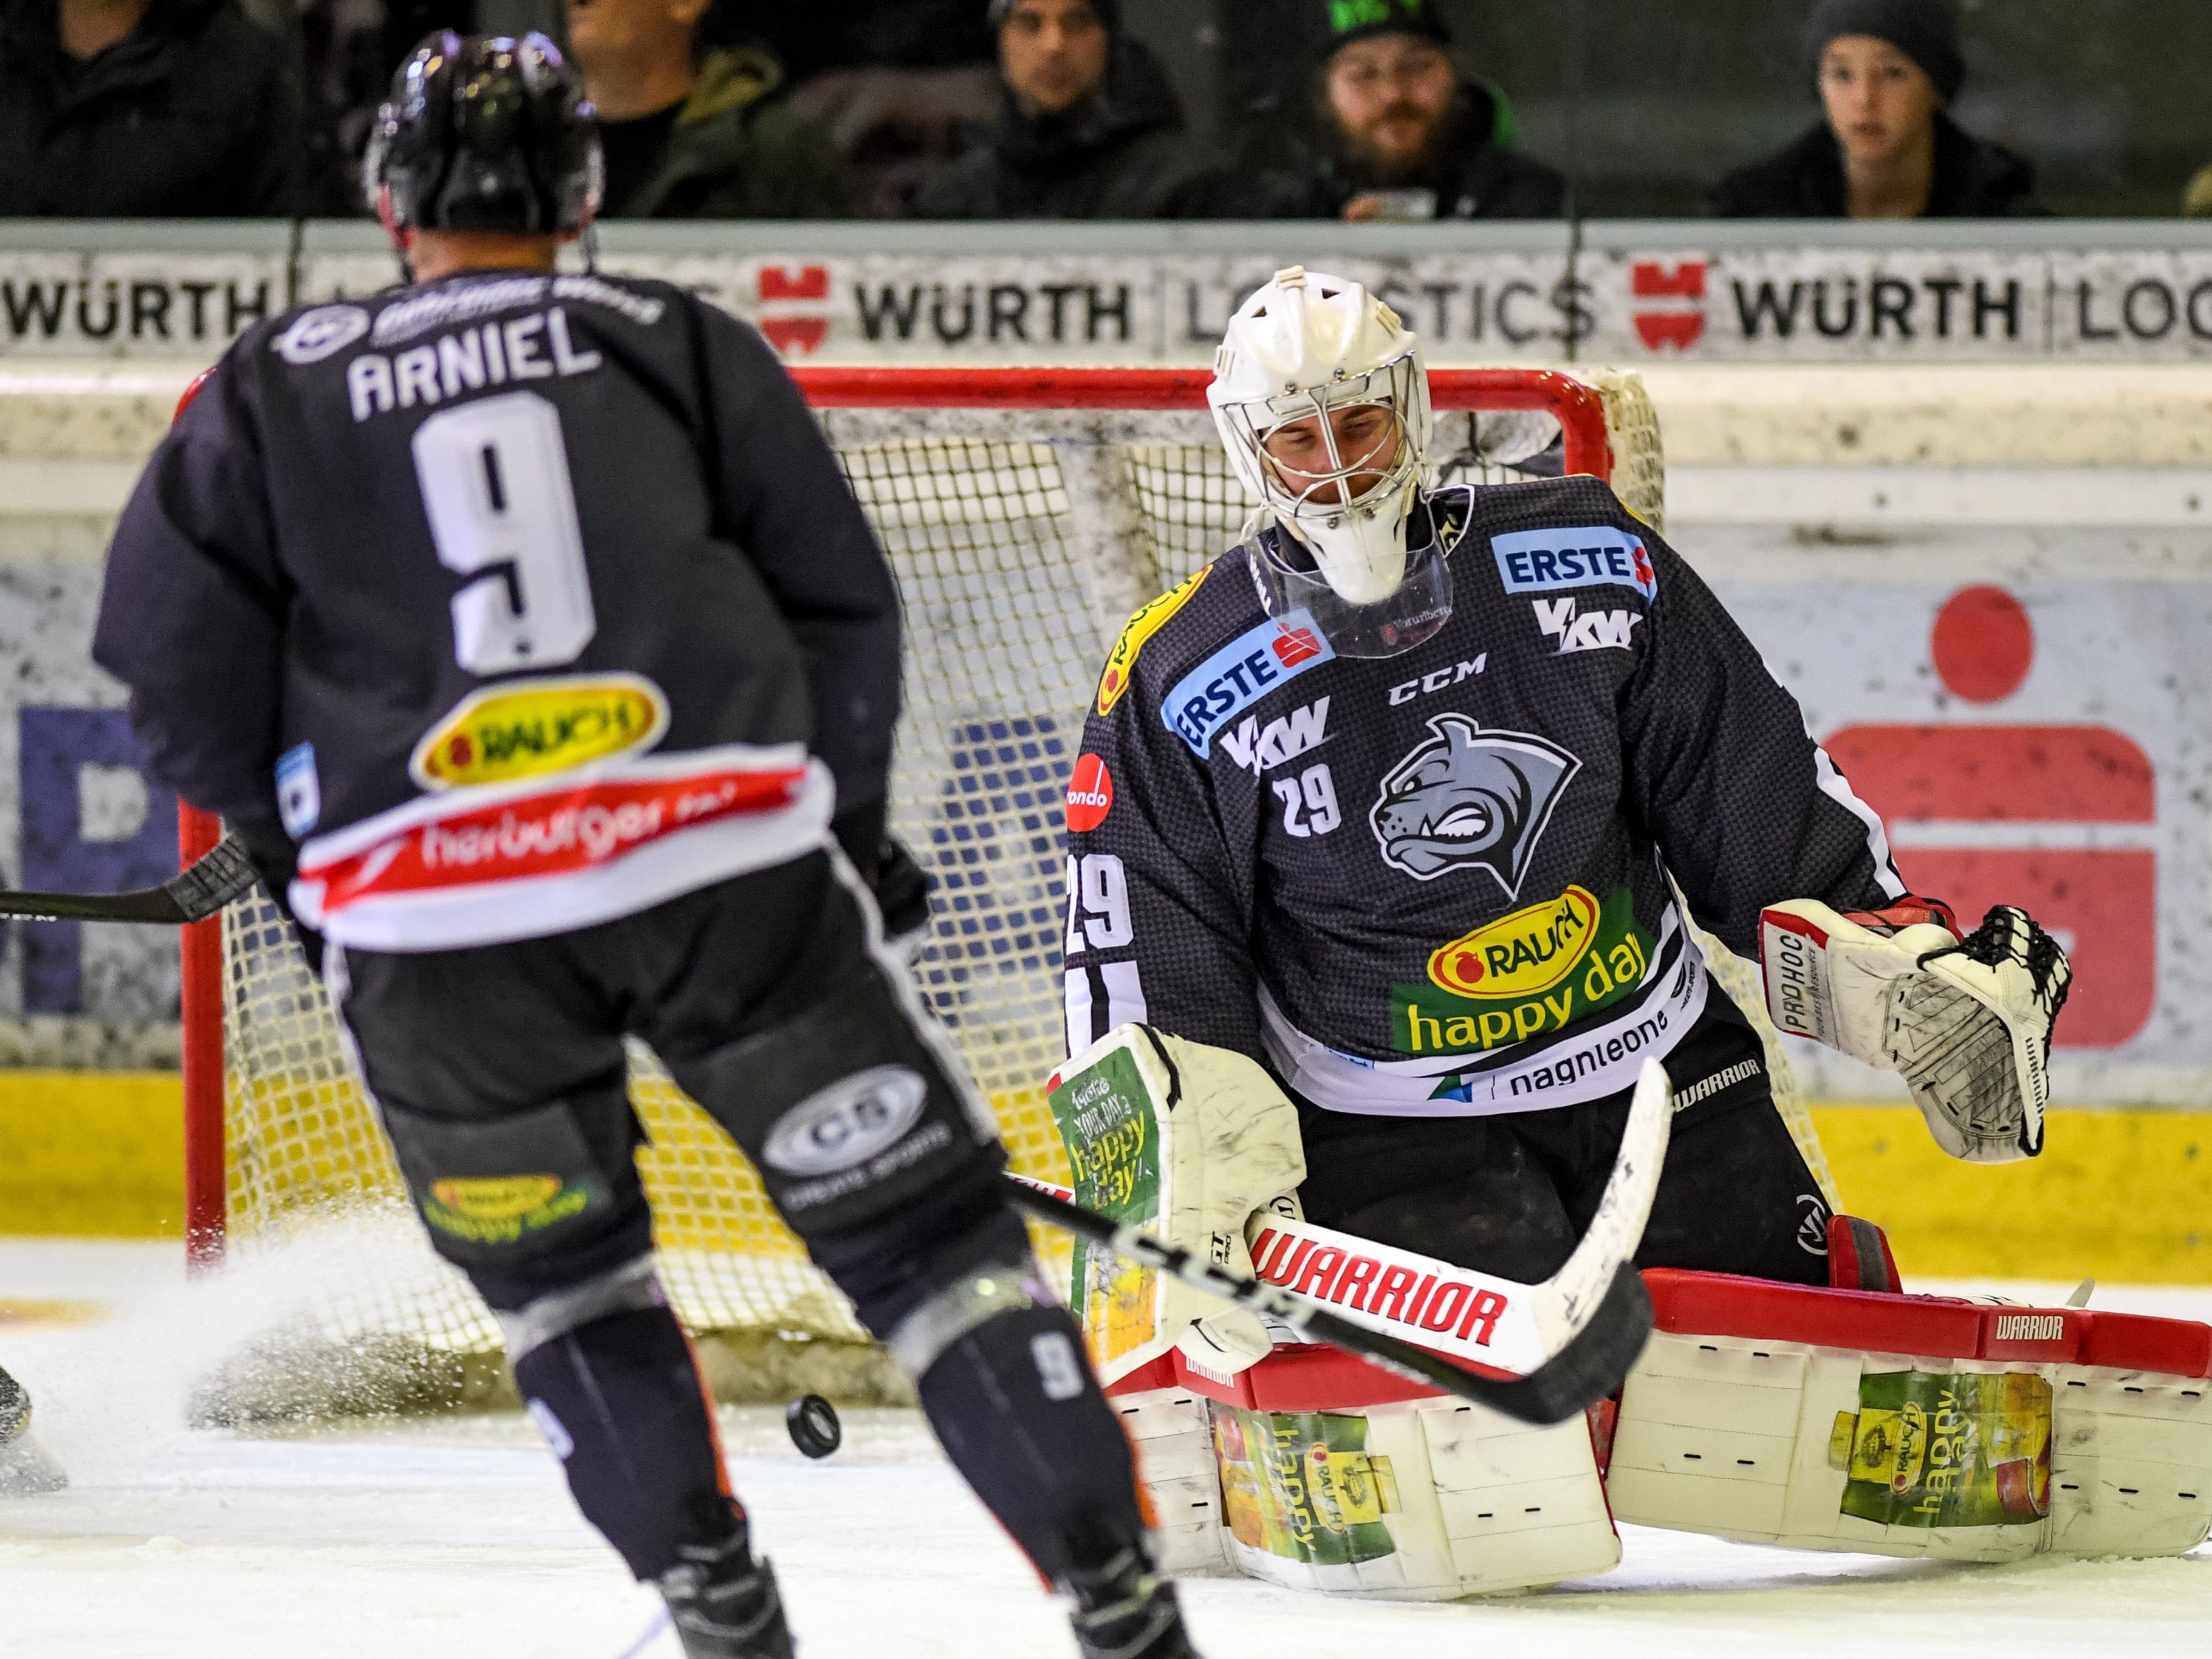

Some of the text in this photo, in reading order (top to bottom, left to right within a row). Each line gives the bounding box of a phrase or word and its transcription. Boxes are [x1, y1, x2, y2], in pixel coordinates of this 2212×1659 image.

[2, 278, 267, 340] WÜRTH
[854, 280, 1595, 343] WÜRTH LSTICS
[1733, 276, 2019, 340] WÜRTH
[348, 306, 602, 422] ARNIEL
[412, 390, 597, 677] 9
[1505, 546, 1631, 583] ERSTE
[1176, 648, 1278, 749] ERSTE
[1388, 652, 1487, 706] CCM
[1272, 762, 1341, 838] 29
[1485, 899, 1584, 978] RAUCH
[1408, 987, 1573, 1051] happy
[1584, 931, 1646, 1002] day
[1779, 934, 1808, 1030] PROHOC
[1673, 1058, 1761, 1113] WARRIOR
[1069, 1109, 1145, 1182] happy
[1250, 1228, 1508, 1347] WARRIOR
[1996, 1315, 2064, 1341] WARRIOR
[1030, 1332, 1084, 1401] 9
[1913, 1389, 1961, 1513] happy
